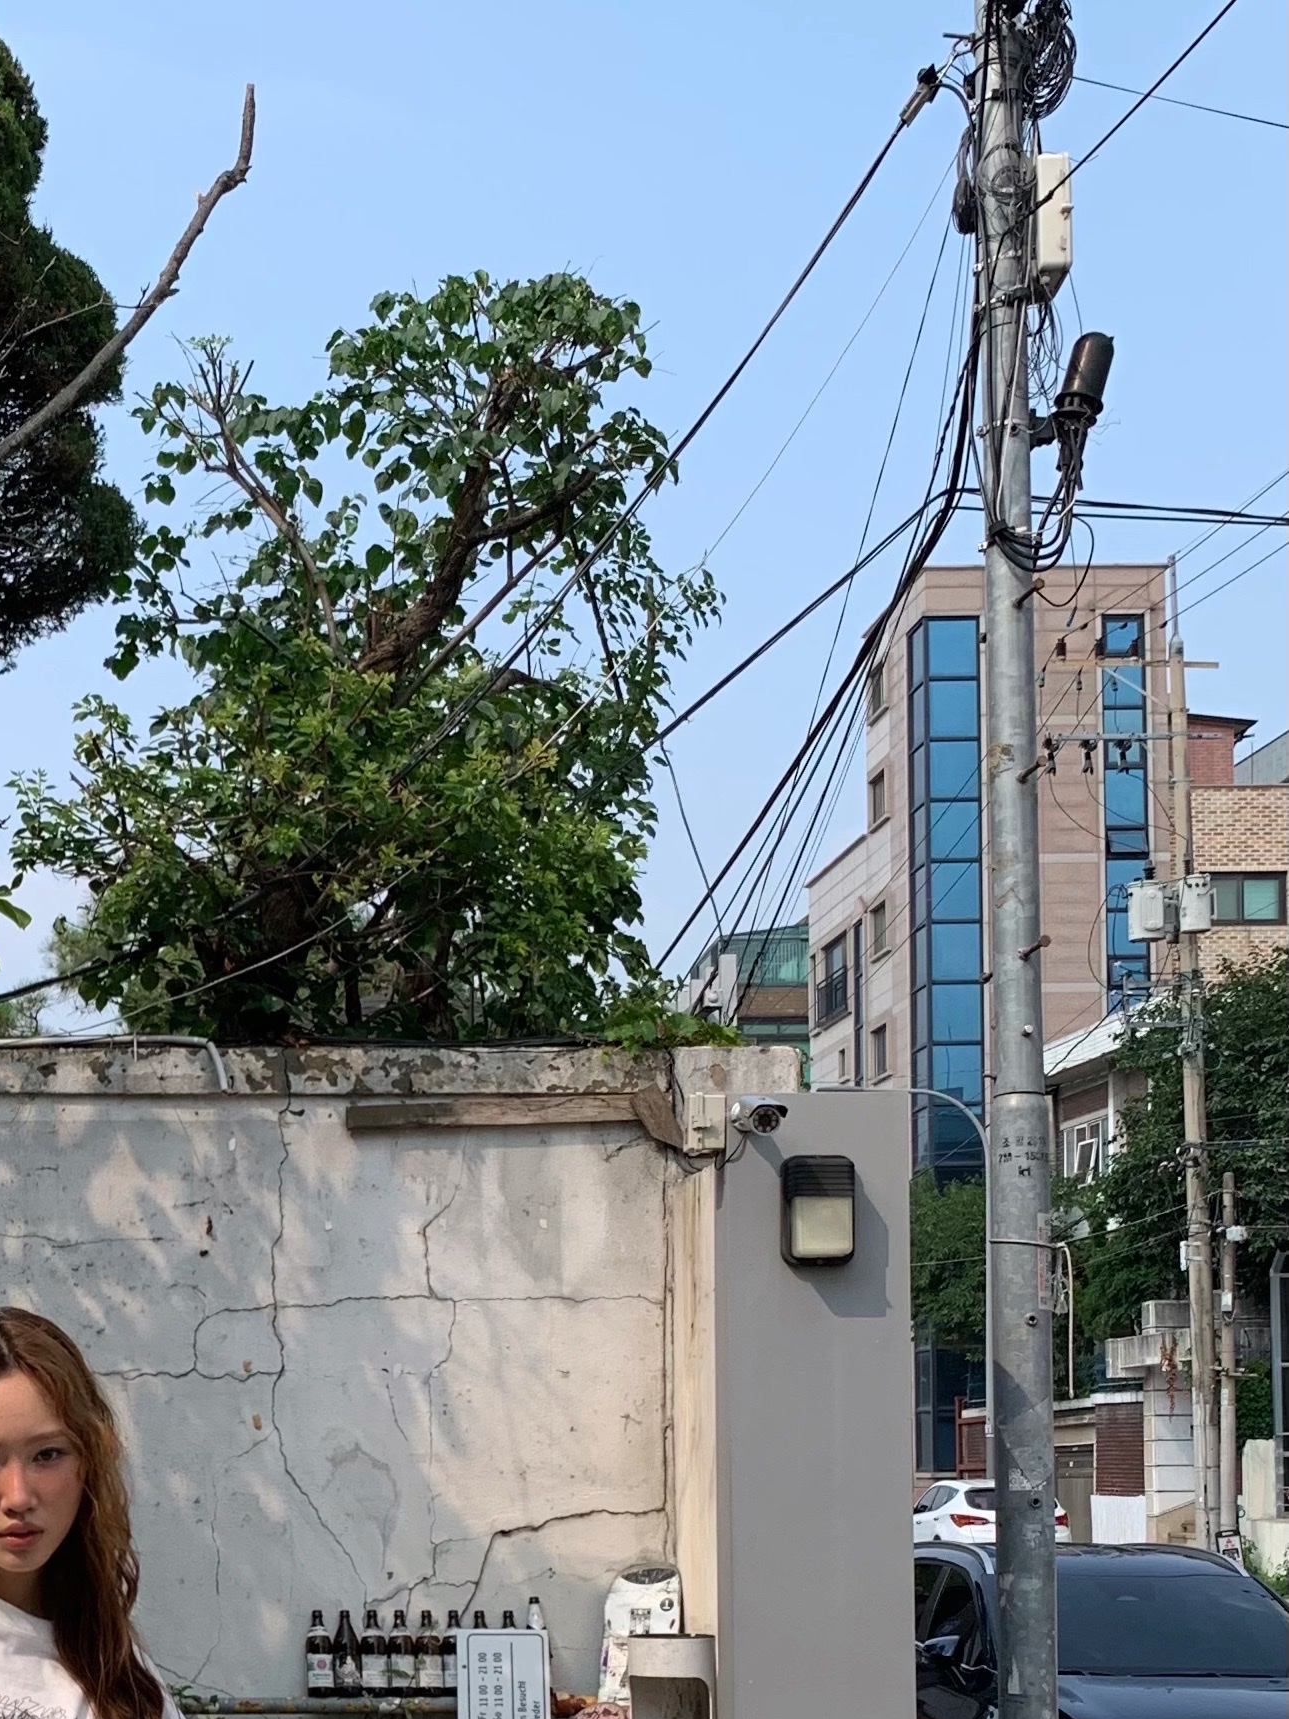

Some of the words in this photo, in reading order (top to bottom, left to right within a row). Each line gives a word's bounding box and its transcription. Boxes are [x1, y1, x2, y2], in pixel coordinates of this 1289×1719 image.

[477, 1652, 487, 1663] 00
[492, 1652, 502, 1663] 00
[478, 1665, 488, 1675] 21
[493, 1665, 503, 1675] 21
[478, 1684, 488, 1696] 00
[493, 1684, 504, 1696] 00
[479, 1697, 489, 1707] 11
[494, 1697, 504, 1707] 11
